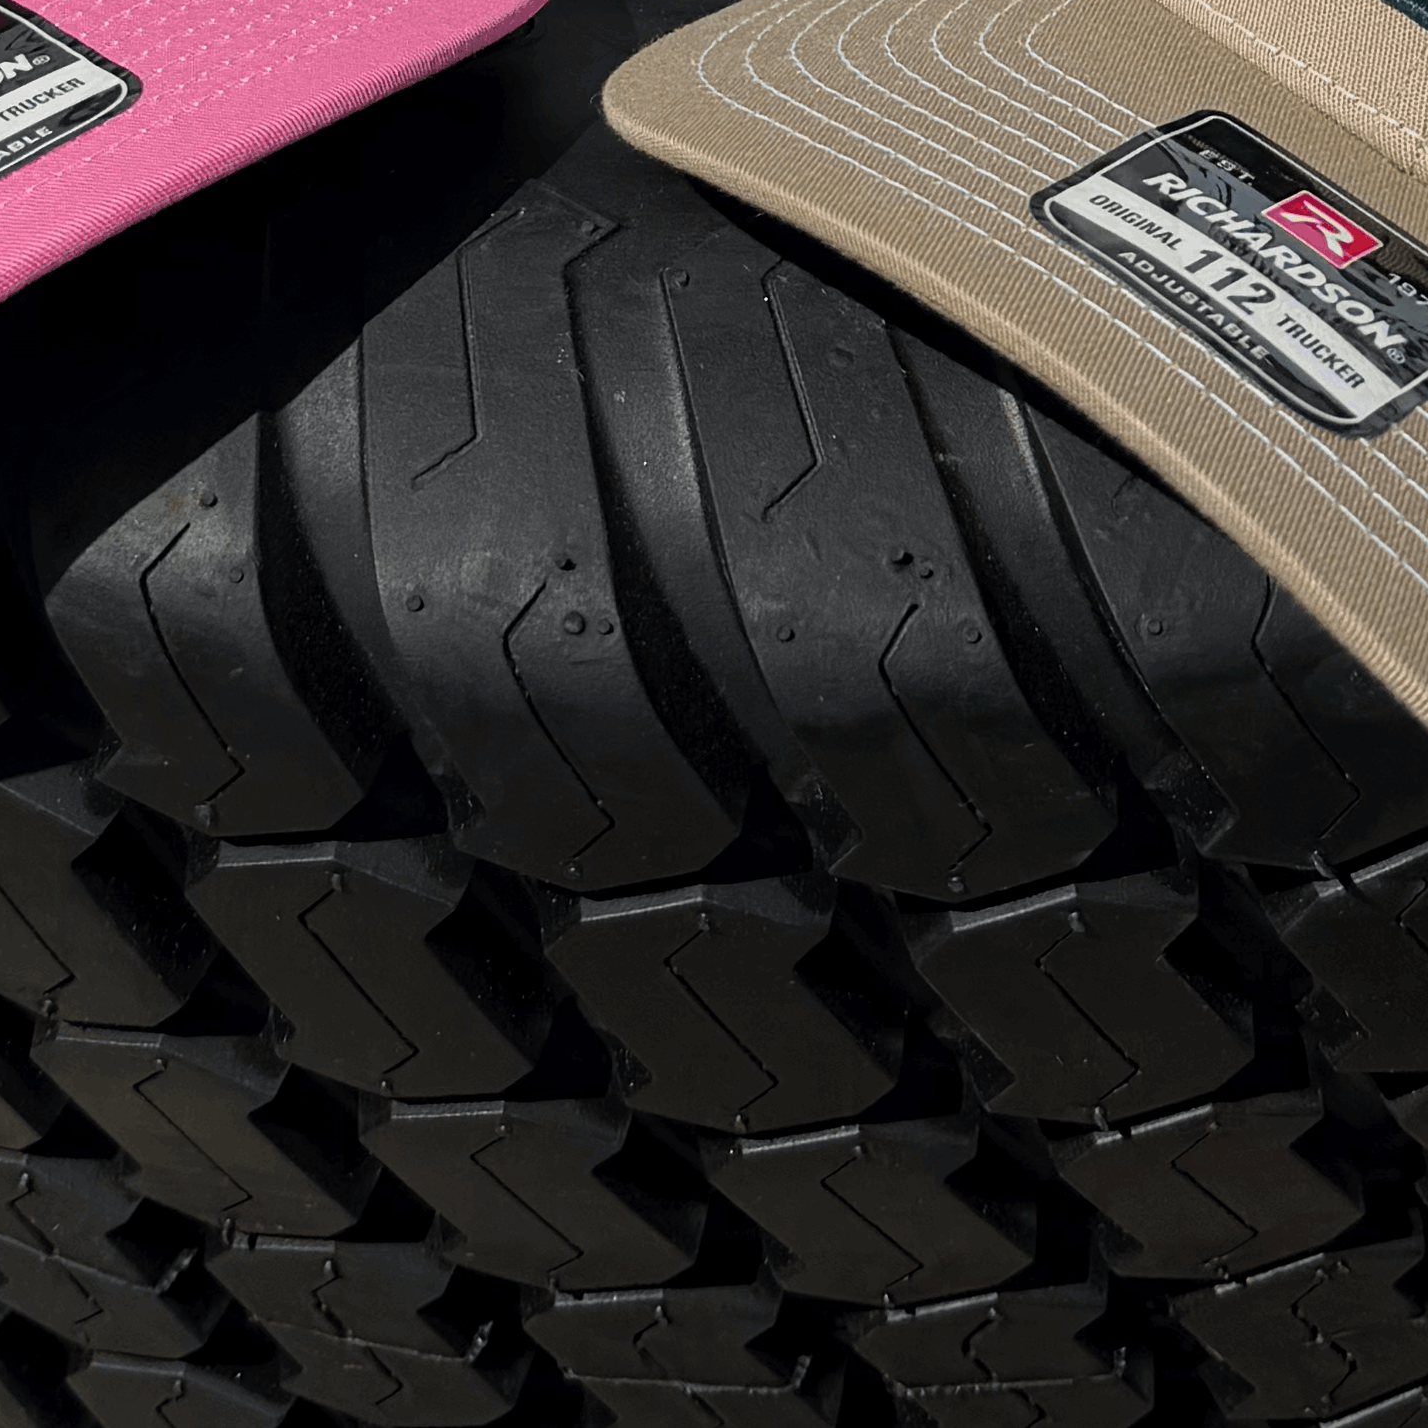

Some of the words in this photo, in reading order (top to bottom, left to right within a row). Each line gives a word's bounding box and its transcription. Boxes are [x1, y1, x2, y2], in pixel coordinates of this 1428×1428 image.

[1198, 147, 1256, 188] EST.
[1088, 193, 1183, 252] ORIGINAL
[1184, 249, 1278, 317] 112
[1276, 313, 1365, 390] TRUCKER
[1117, 250, 1271, 362] ADJUSTABLE
